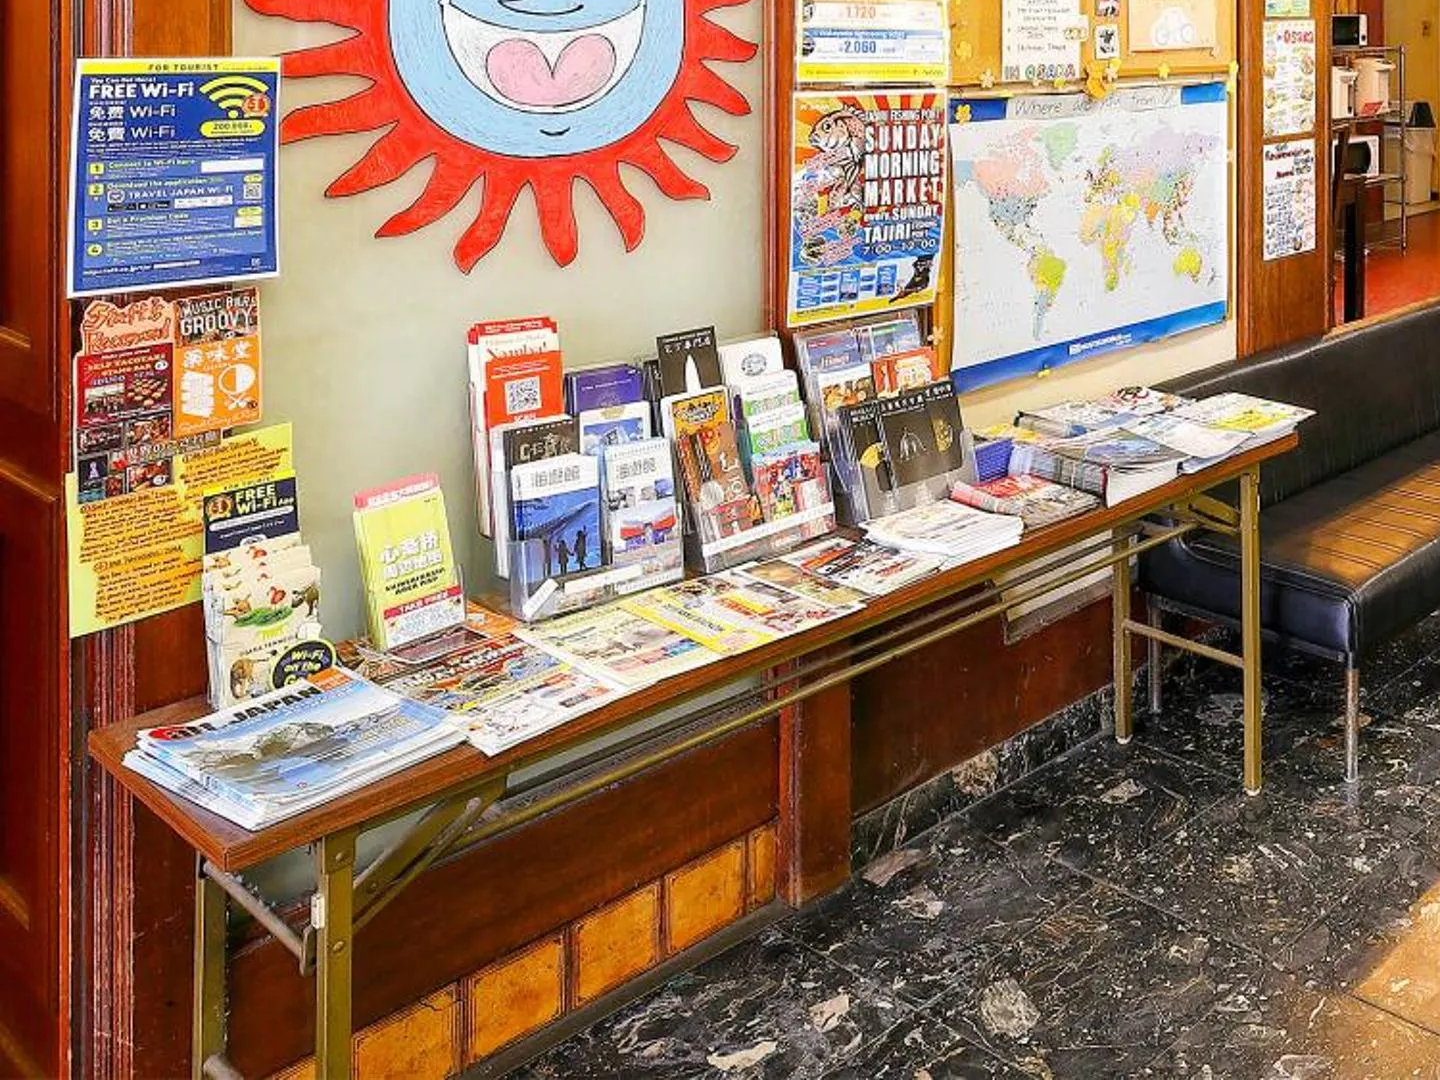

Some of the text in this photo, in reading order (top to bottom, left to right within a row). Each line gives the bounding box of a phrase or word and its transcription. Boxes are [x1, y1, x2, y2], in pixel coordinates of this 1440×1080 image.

[89, 81, 194, 99] FREE Wi-Fi
[130, 104, 176, 118] Wi-Fi
[1015, 99, 1062, 116] Where
[131, 125, 176, 138] Wi-Fi
[865, 123, 940, 152] SUNDAY
[865, 150, 940, 179] MORNING
[129, 189, 168, 198] TRAVEL
[171, 187, 204, 197] JAPAN
[865, 177, 940, 207] MARKET
[892, 204, 939, 221] SUNDAY
[864, 222, 911, 244] TAJIRI
[183, 298, 221, 318] MUSIC
[180, 307, 253, 337] GROOVY
[235, 484, 277, 502] FREE
[236, 497, 277, 515] Wi-Fi
[230, 686, 322, 724] JAPAN
